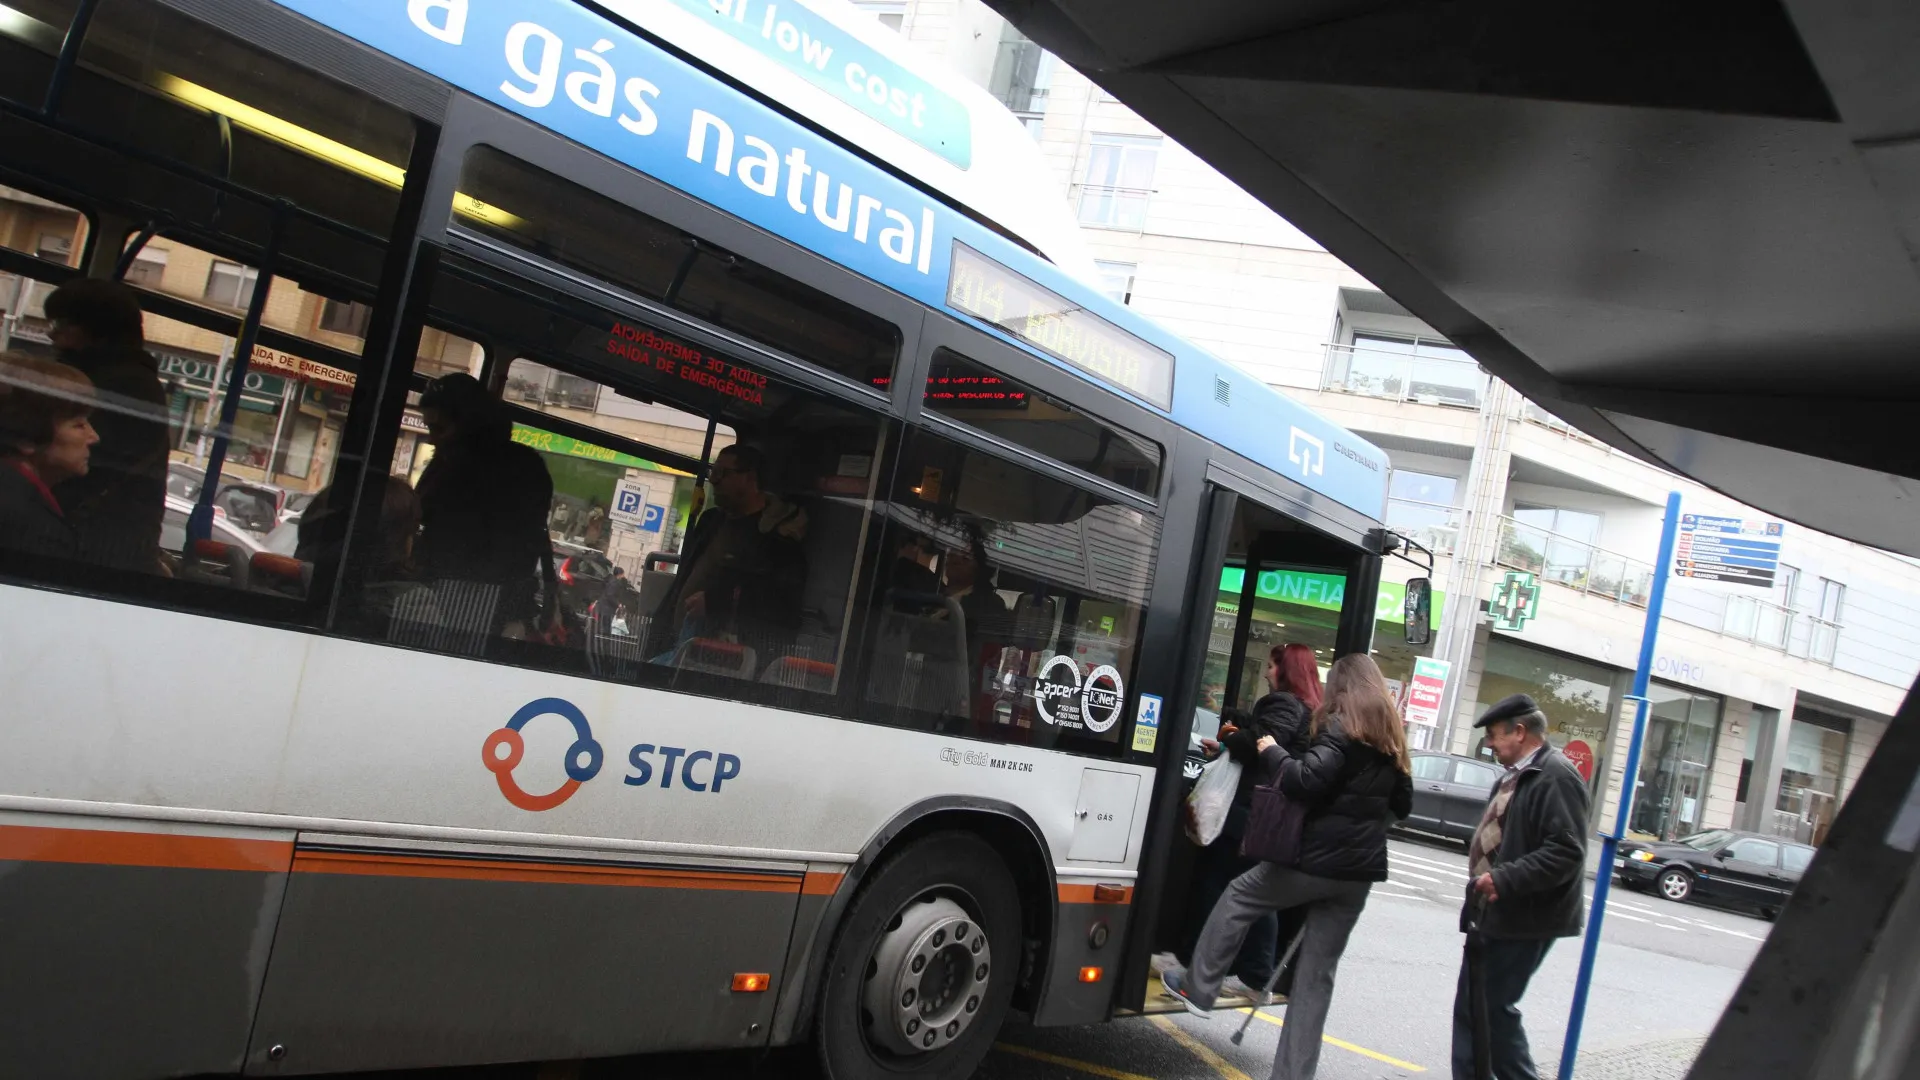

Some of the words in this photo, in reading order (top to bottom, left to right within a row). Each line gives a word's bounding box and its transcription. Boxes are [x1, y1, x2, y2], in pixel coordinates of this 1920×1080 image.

[762, 4, 833, 71] low
[845, 62, 926, 128] cost
[406, 0, 468, 46] a
[500, 21, 661, 137] gás
[687, 109, 935, 275] natural
[280, 355, 295, 367] DE
[606, 339, 650, 366] SAÍDA
[656, 357, 676, 375] DE
[680, 365, 763, 406] EMERGÊNCIA
[1333, 440, 1379, 472] CAETANO
[625, 483, 641, 492] zona
[622, 493, 637, 510] P
[641, 506, 658, 526] P
[1043, 681, 1074, 699] apcer
[1136, 726, 1156, 738] AGENTE
[624, 743, 741, 793] STCP
[940, 747, 962, 766] City
[964, 751, 989, 767] Gold
[990, 758, 1007, 769] MAN
[1008, 760, 1018, 771] 2K
[1018, 762, 1034, 772] CNG
[1097, 812, 1113, 822] GÁS
